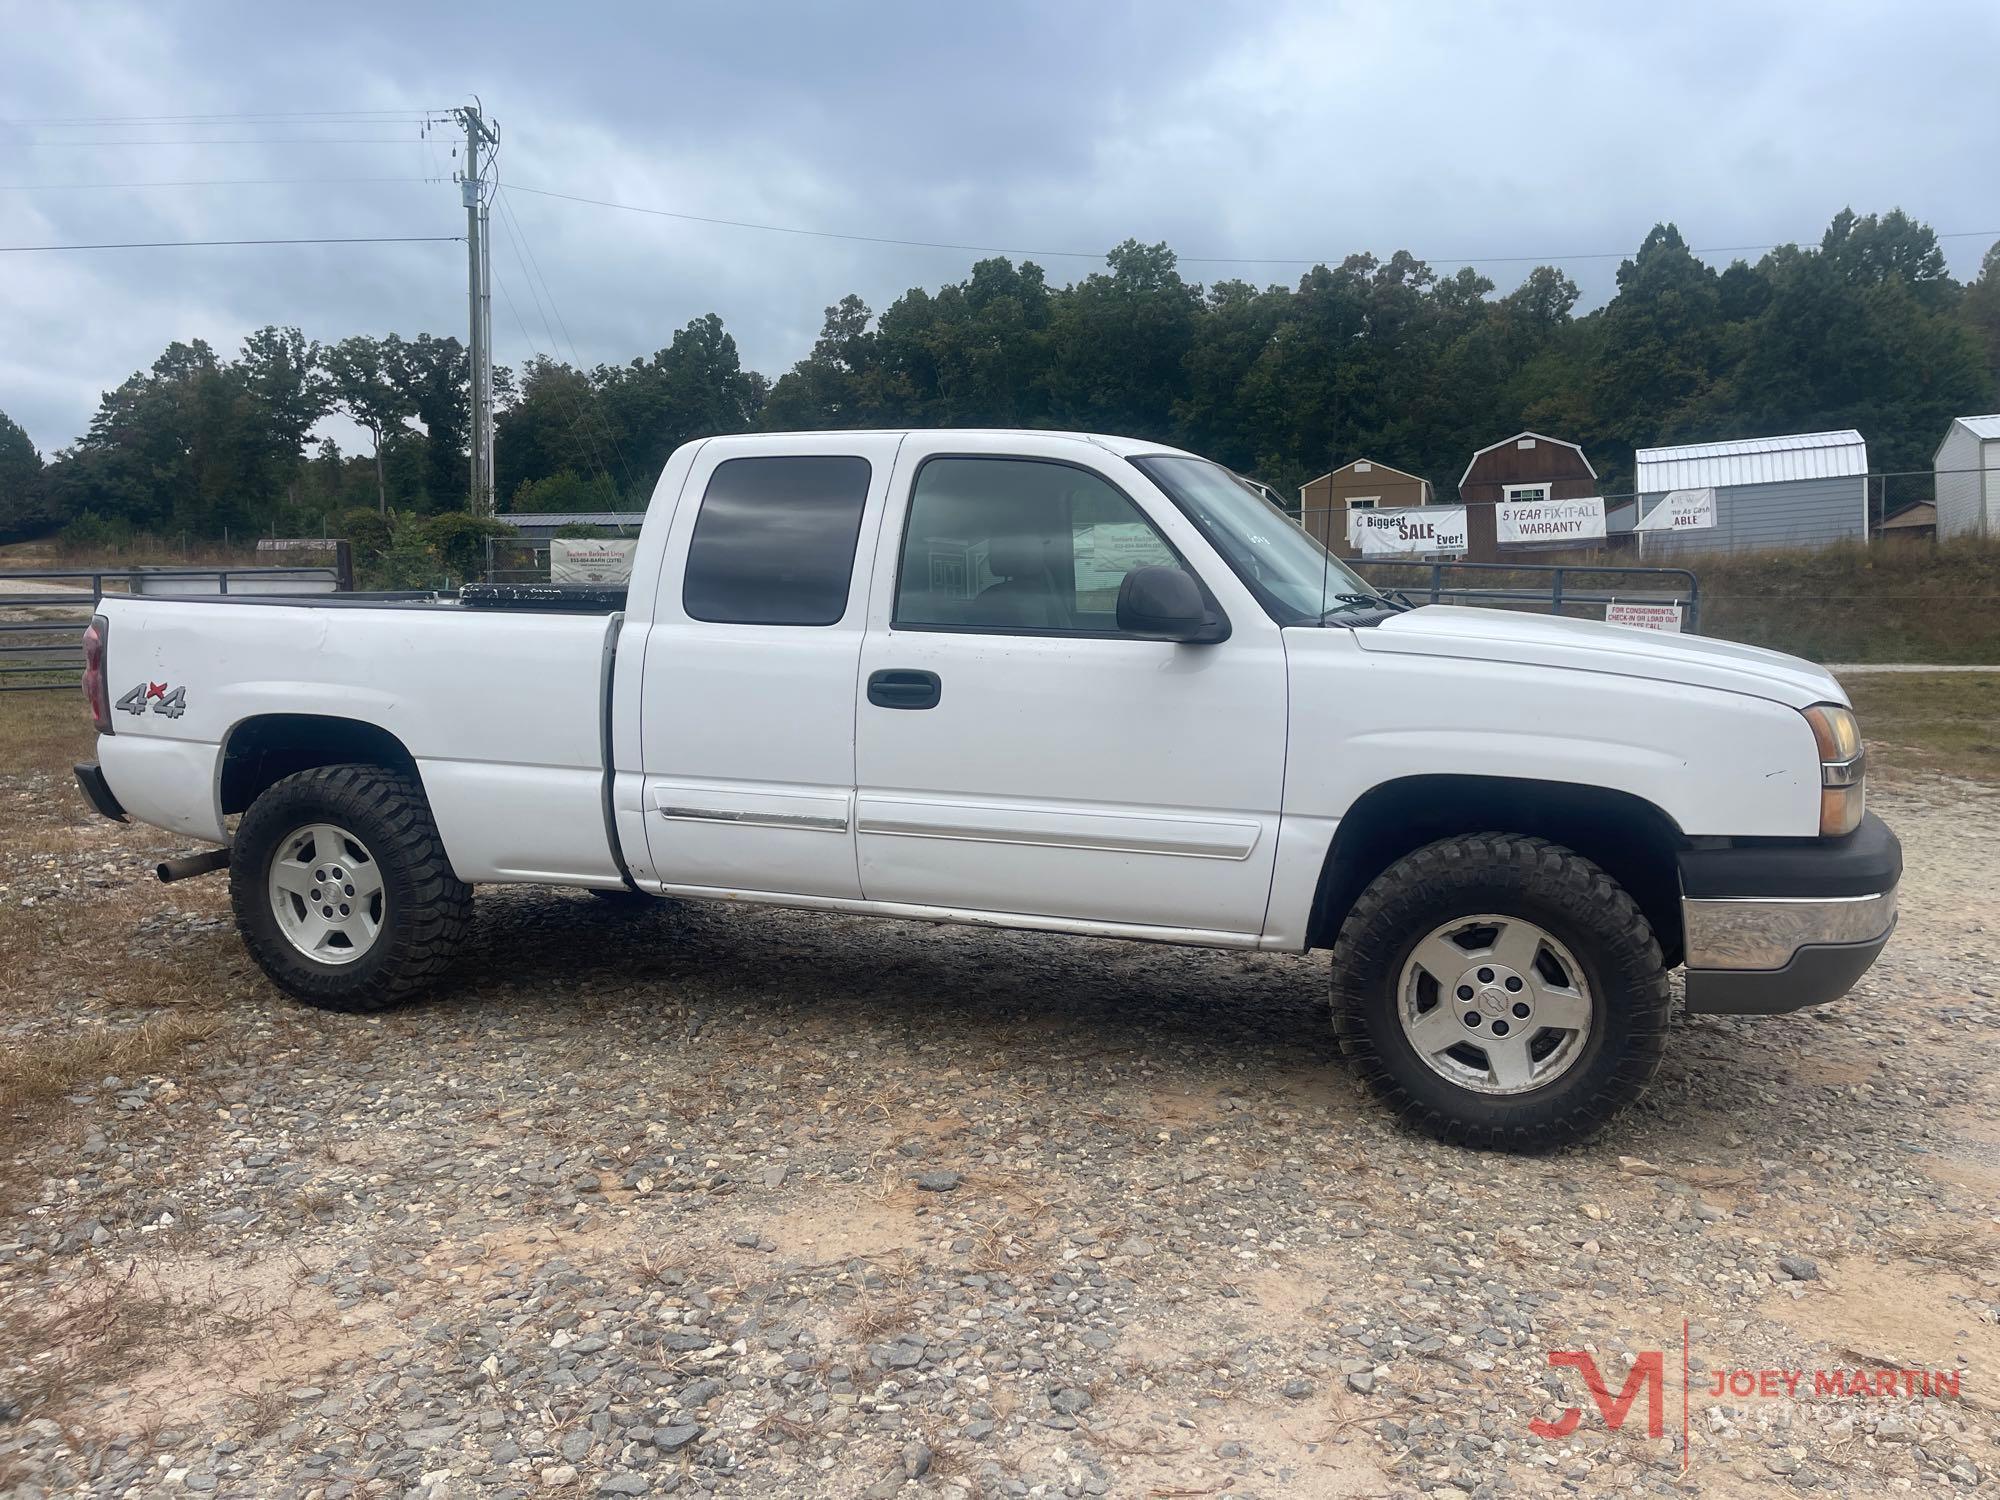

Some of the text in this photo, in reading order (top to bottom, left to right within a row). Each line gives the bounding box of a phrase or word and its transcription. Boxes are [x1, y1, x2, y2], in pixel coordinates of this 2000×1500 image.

[1503, 506, 1598, 521] 5 YEAR FIX-IT-ALL
[1367, 516, 1406, 529] Biggest
[1519, 520, 1582, 534] WARRANTY
[1399, 523, 1435, 540] SALE
[1437, 533, 1463, 545] Ever!
[1625, 607, 1675, 616] CONSIGNMENTS,
